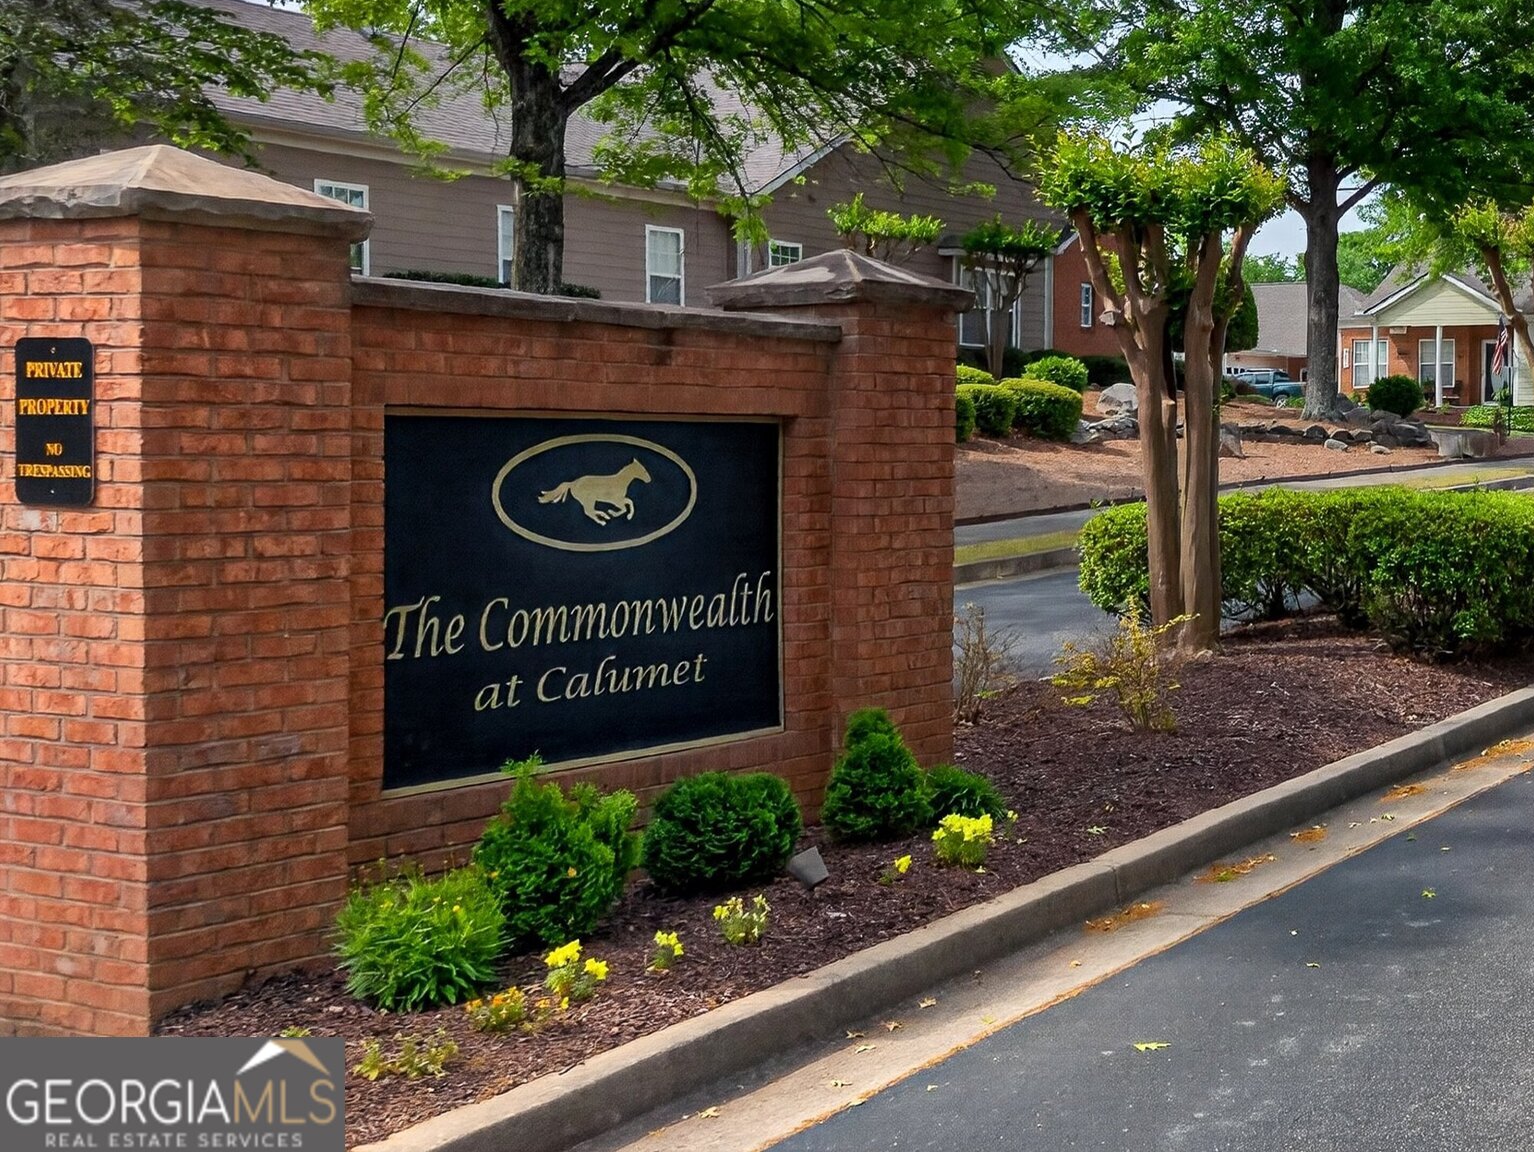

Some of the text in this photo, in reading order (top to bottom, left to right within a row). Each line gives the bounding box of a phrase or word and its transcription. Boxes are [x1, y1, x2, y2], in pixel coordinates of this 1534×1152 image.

[26, 361, 83, 379] PRIVATE
[18, 399, 90, 416] PROPERTY
[45, 443, 63, 457] NO
[17, 464, 91, 479] TRESPASSING
[384, 570, 775, 660] The Commonwealth
[473, 653, 708, 712] at Calumet
